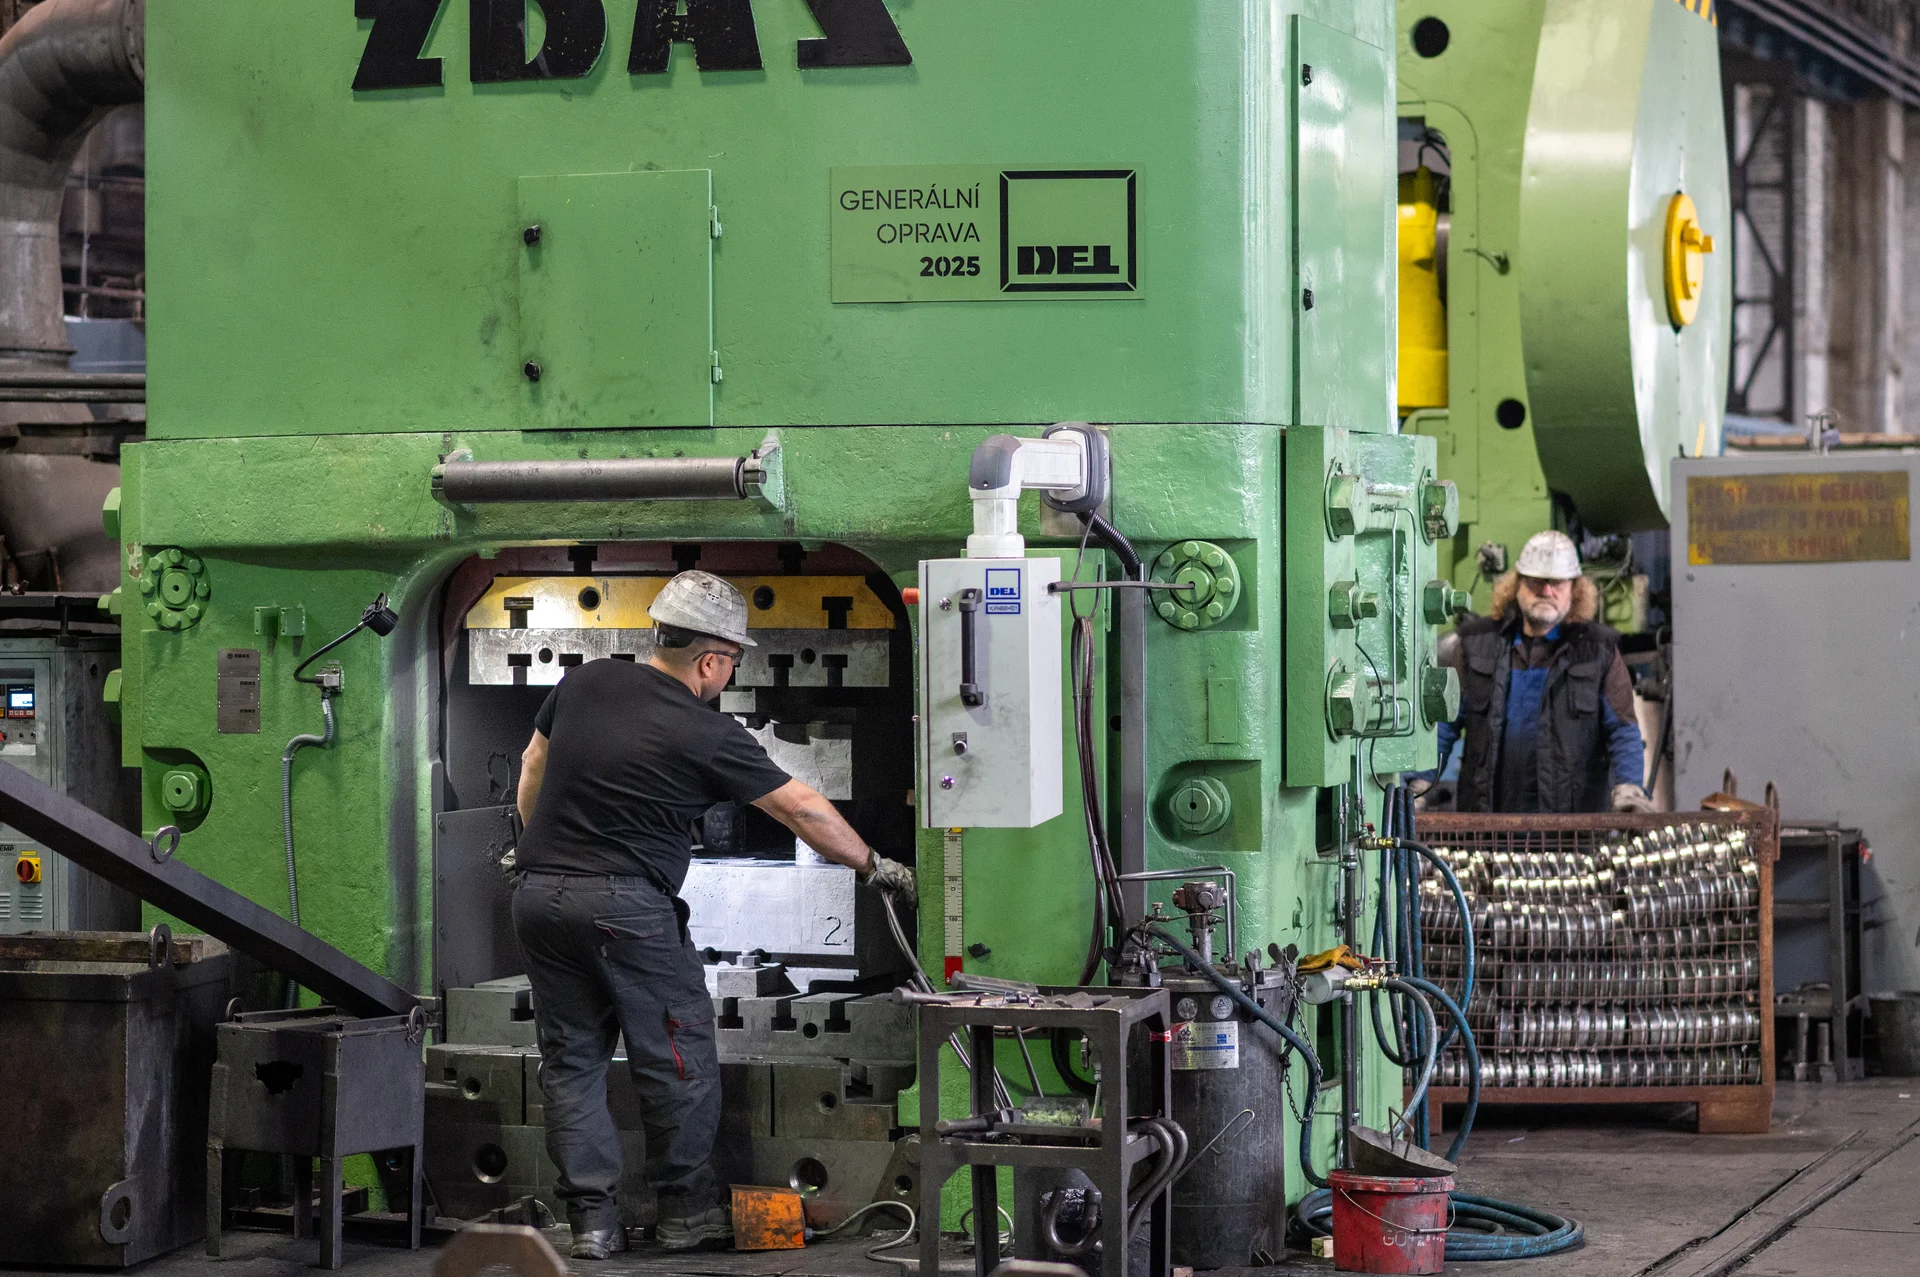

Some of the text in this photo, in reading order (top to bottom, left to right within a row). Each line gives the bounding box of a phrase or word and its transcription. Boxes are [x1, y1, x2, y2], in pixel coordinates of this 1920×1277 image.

[839, 182, 981, 211] GENERÁLNÍ
[876, 222, 981, 245] OPRAVA
[919, 256, 981, 277] 2025
[1016, 245, 1120, 275] DEL
[989, 587, 1017, 596] DEL
